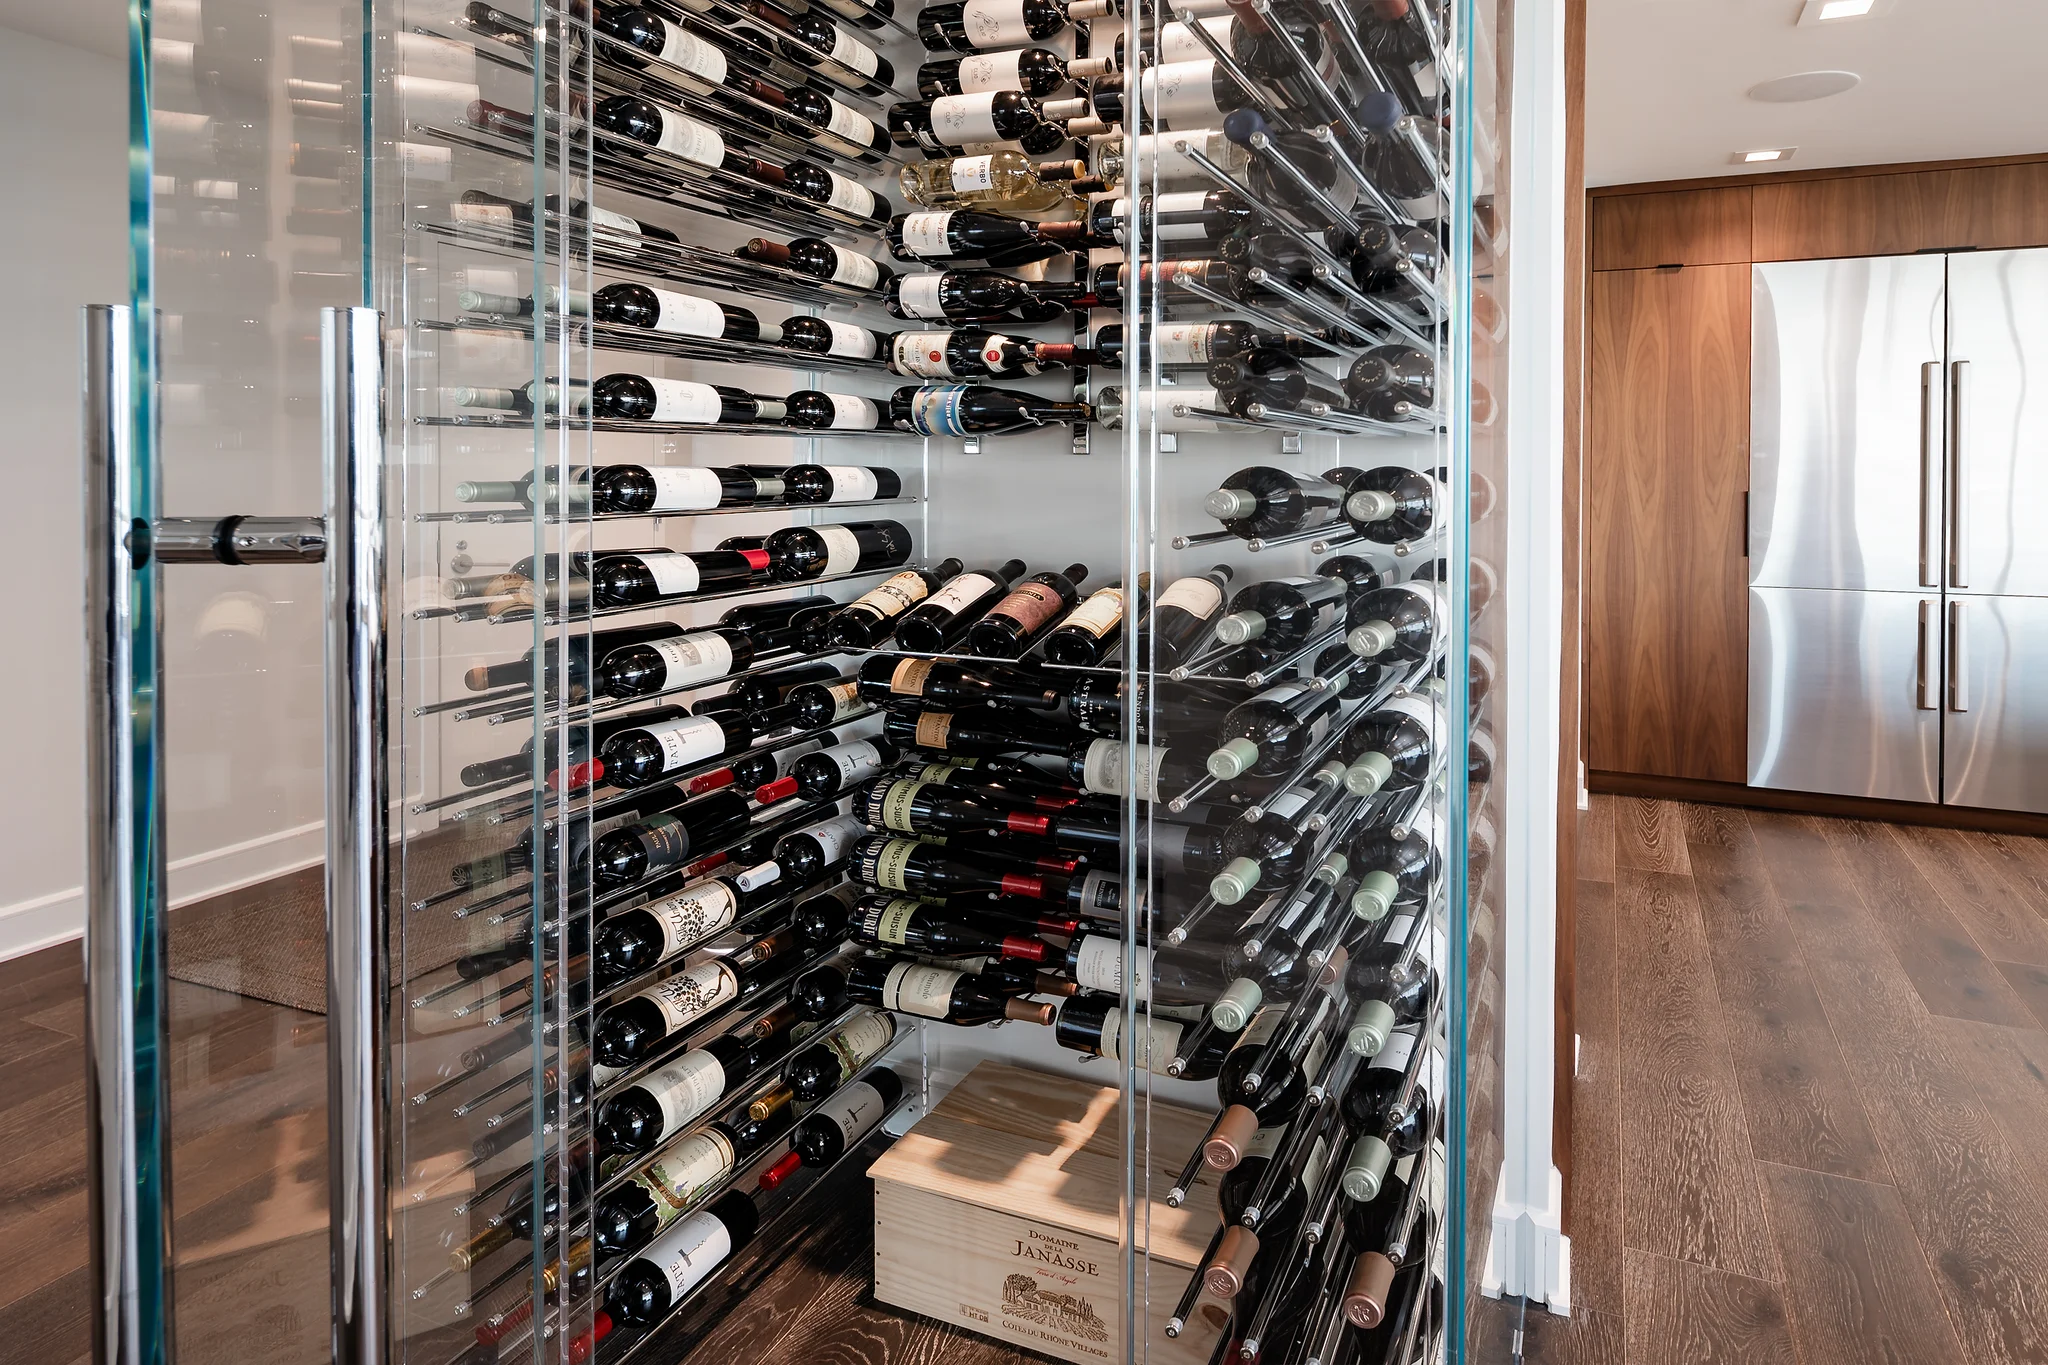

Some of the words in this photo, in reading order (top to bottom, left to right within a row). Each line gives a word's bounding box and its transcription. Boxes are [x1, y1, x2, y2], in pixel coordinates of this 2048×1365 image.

[978, 25, 987, 37] CLIO
[978, 160, 988, 184] VERBO
[940, 278, 950, 304] GAJA
[660, 642, 680, 663] Groth
[909, 662, 925, 688] STANTON
[1079, 677, 1094, 724] ASTRAL
[933, 715, 945, 743] STANTON
[664, 735, 679, 768] TATE
[922, 972, 940, 1000] Emmolo
[681, 1065, 699, 1088] PHELPS
[1028, 1230, 1080, 1251] DOMAINE
[1054, 1246, 1064, 1254] LA
[1010, 1239, 1100, 1277] JANASSE
[1027, 1329, 1039, 1338] DU
[1071, 1338, 1108, 1359] VILLAGES
